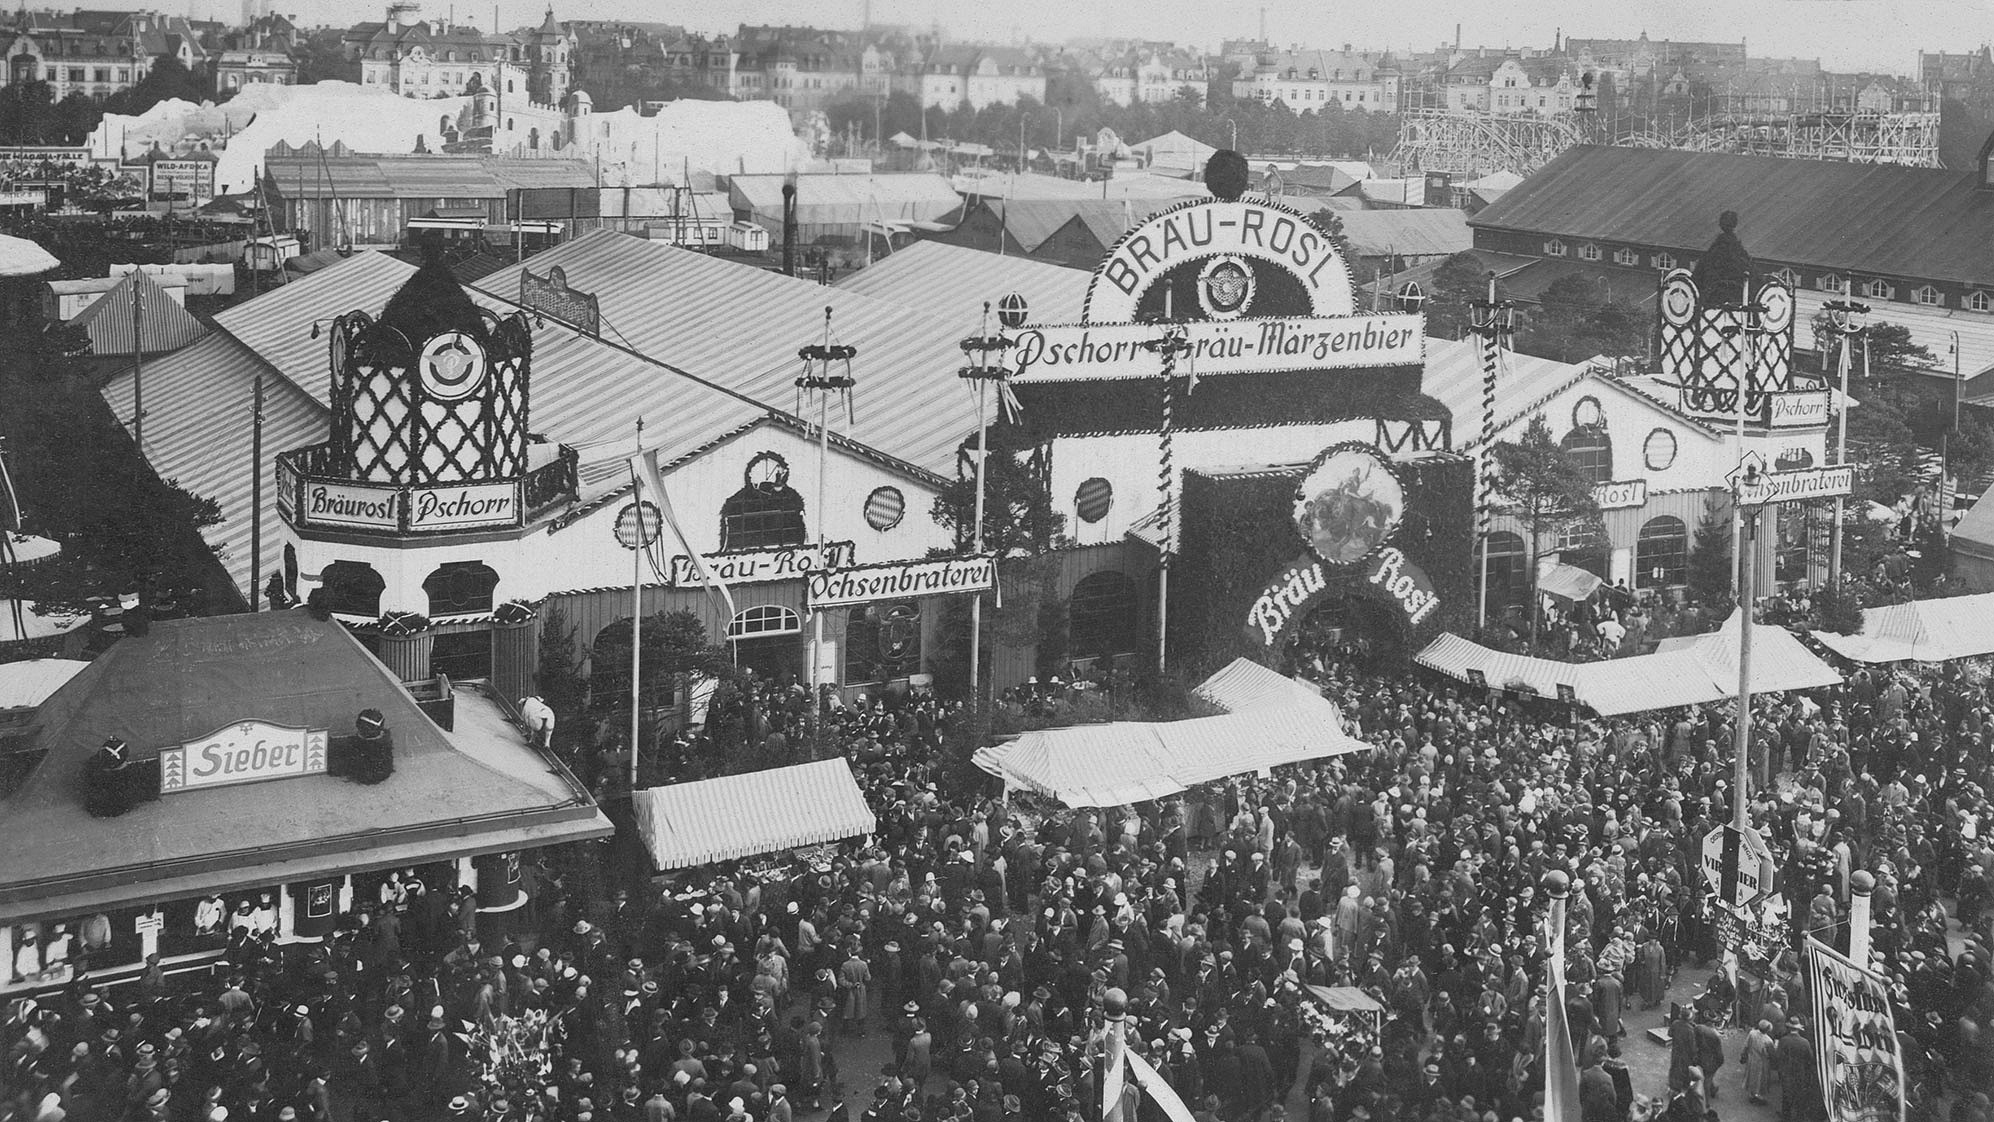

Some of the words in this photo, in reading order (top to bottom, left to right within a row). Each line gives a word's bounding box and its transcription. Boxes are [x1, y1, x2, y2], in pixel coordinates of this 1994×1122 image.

[1774, 397, 1823, 419] Pschorr
[415, 490, 511, 524] Pschorr
[810, 560, 990, 600] Ochsenbraterei
[1248, 563, 1327, 646] Bräu
[193, 739, 300, 777] Sieber
